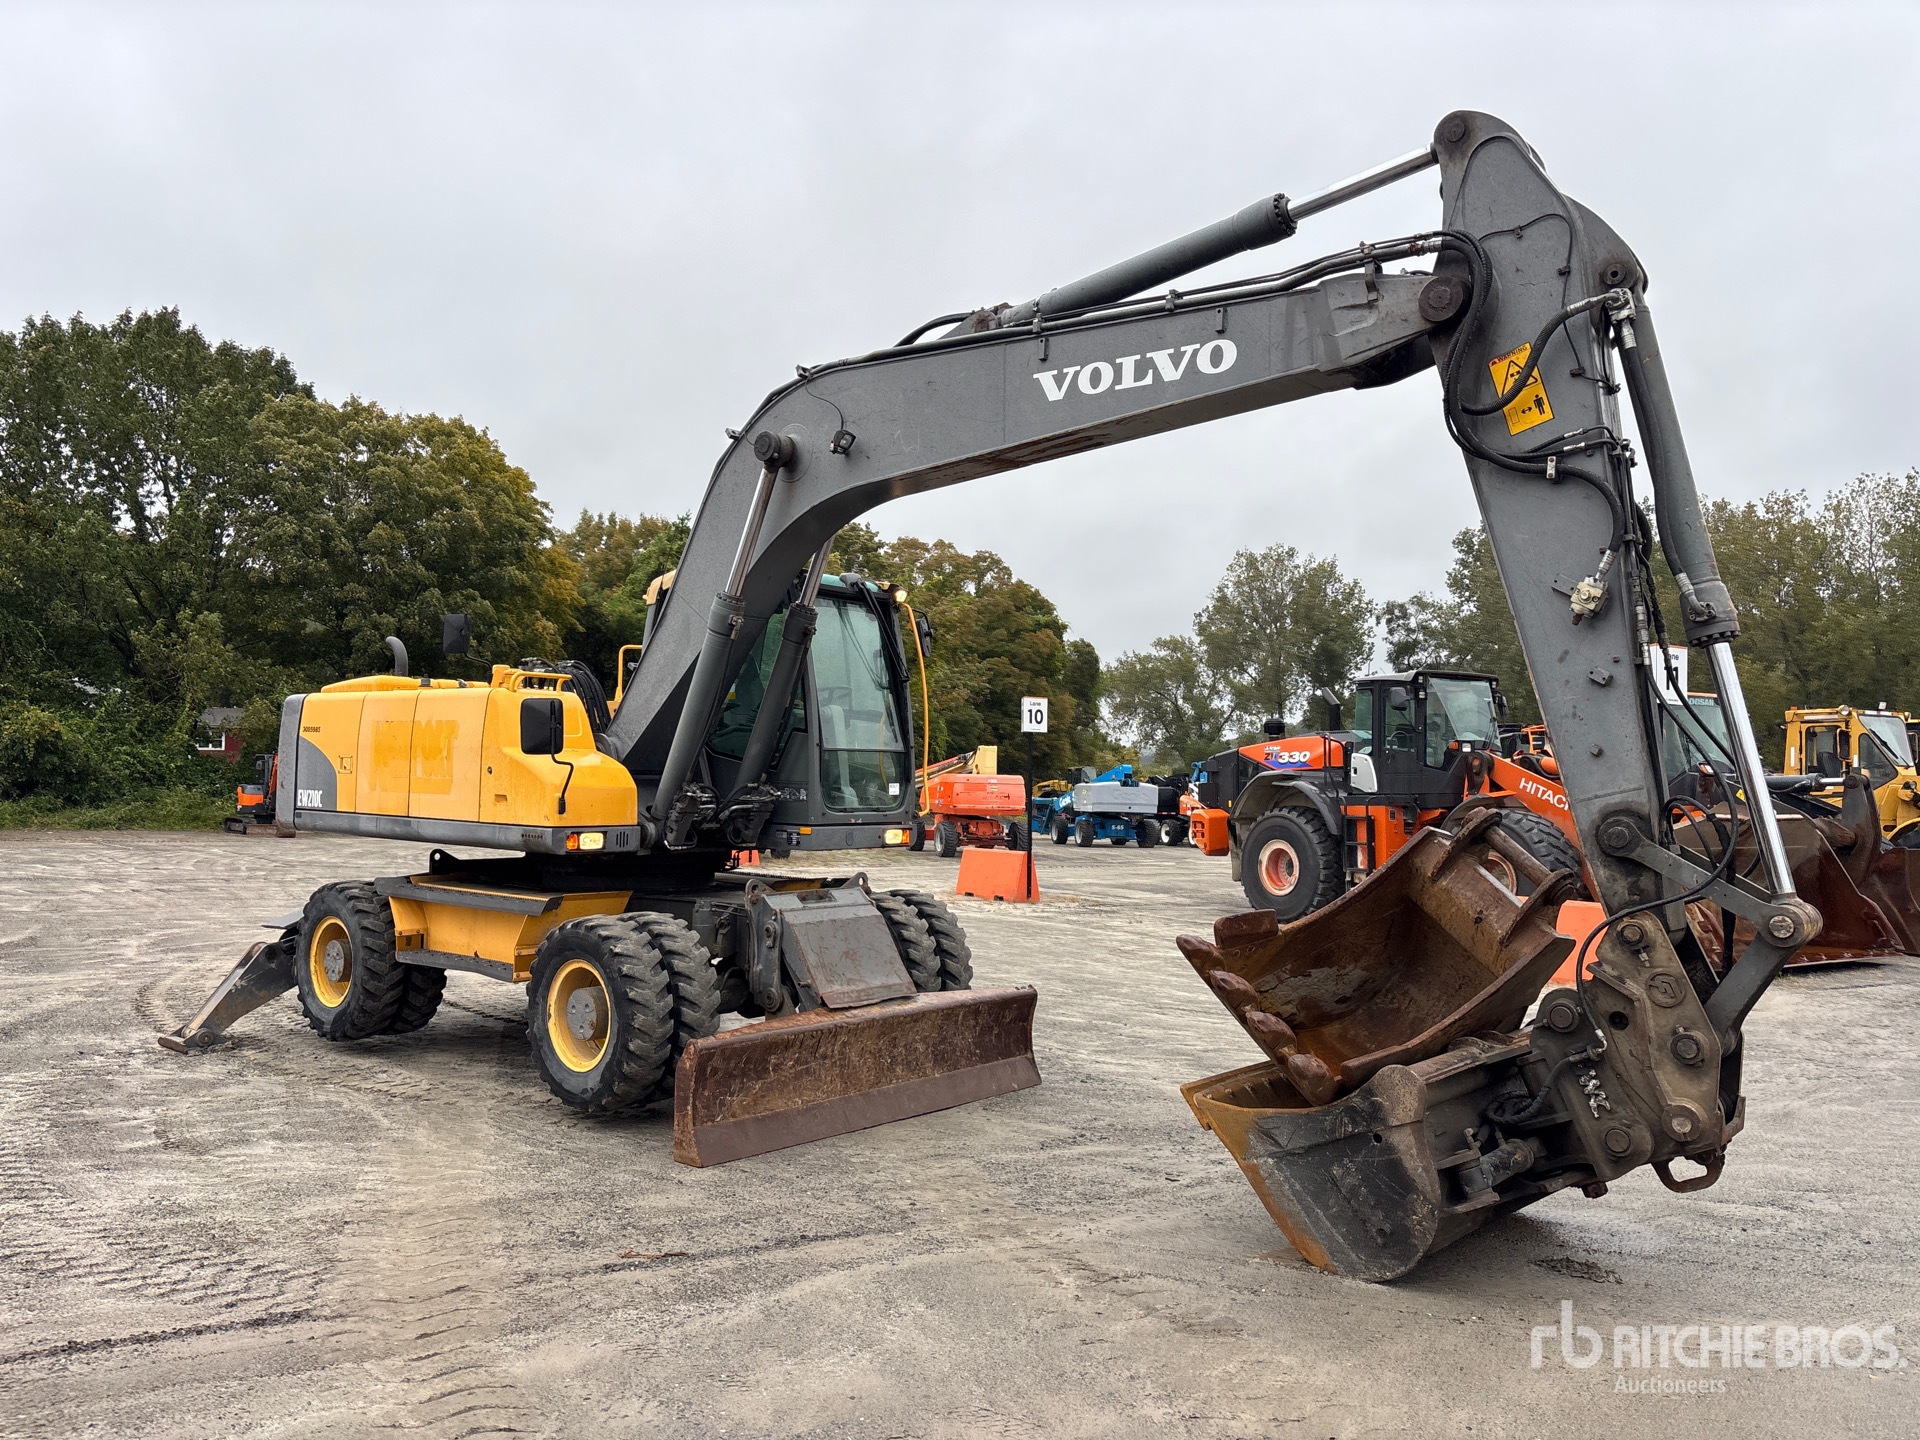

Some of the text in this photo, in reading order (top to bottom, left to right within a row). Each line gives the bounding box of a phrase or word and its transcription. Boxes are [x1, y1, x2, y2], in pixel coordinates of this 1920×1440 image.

[1033, 339, 1238, 402] VOLVO
[1028, 709, 1043, 724] 10
[298, 789, 322, 807] EW210C
